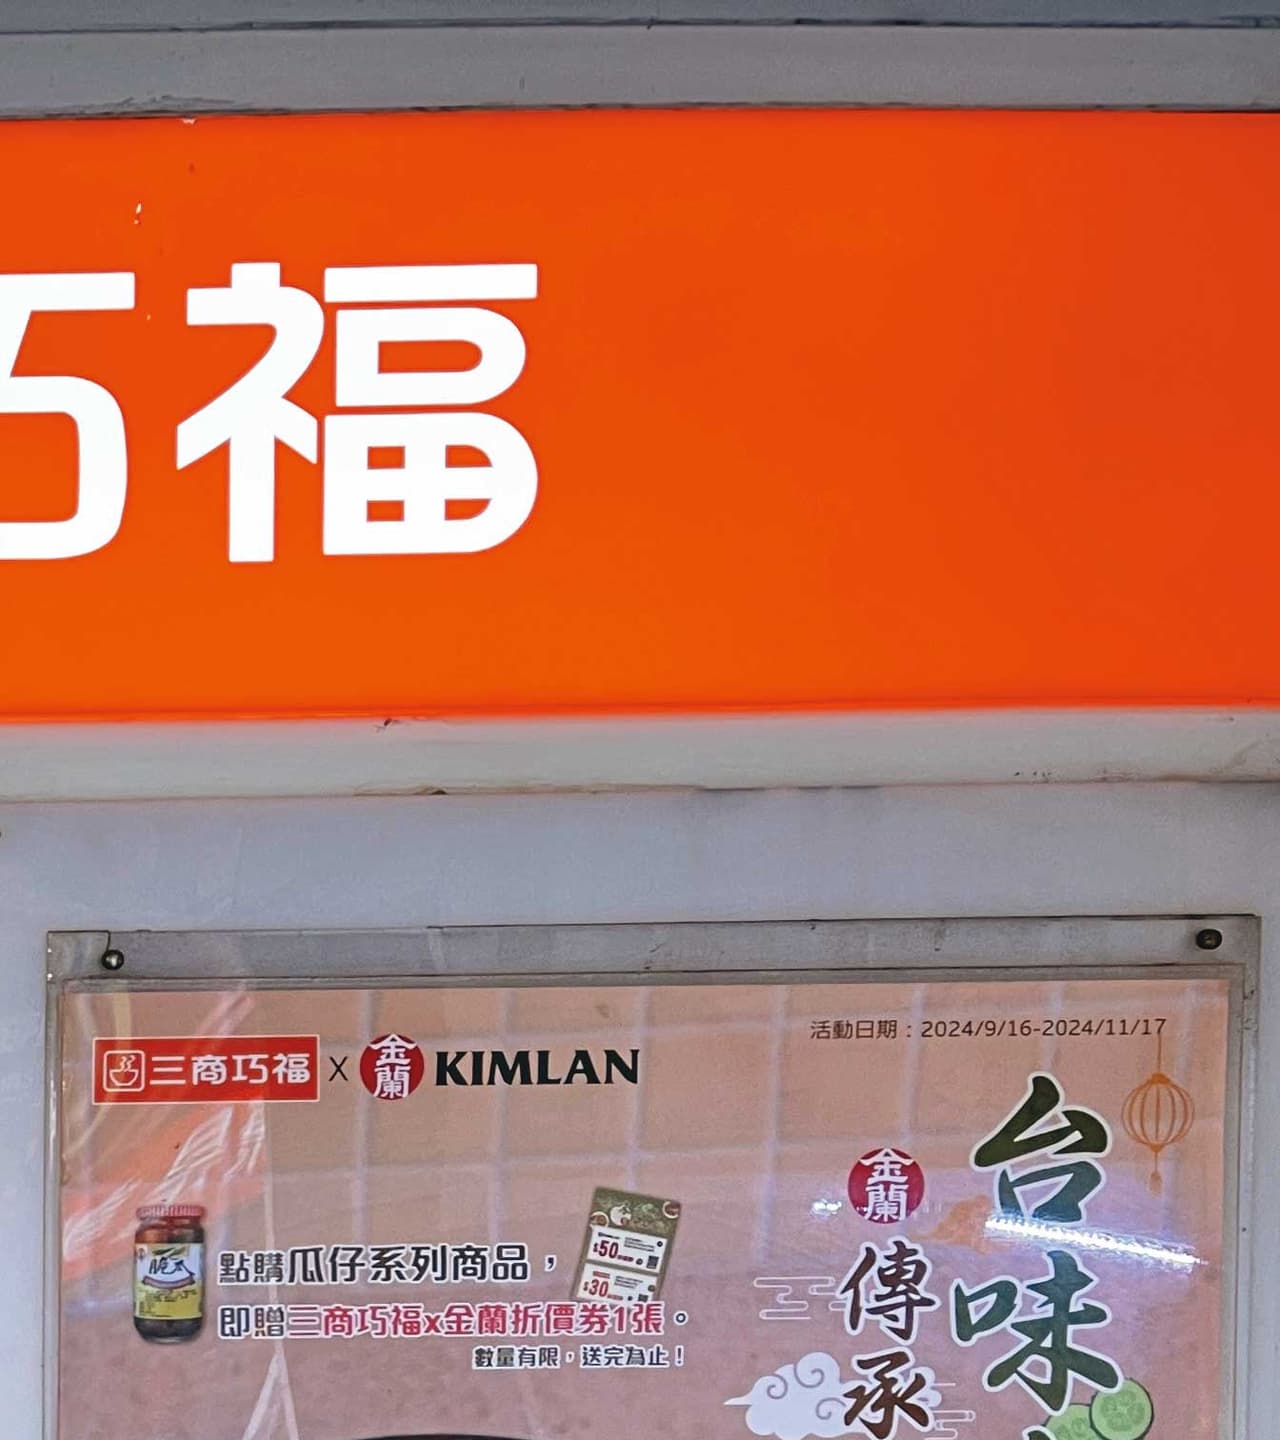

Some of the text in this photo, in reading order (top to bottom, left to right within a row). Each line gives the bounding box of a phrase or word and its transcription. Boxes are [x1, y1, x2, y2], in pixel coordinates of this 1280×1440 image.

[149, 1053, 311, 1086] 三商巧福
[366, 1034, 418, 1099] 金蘭
[435, 1049, 640, 1086] KIMLAN
[857, 1148, 916, 1222] 金蘭
